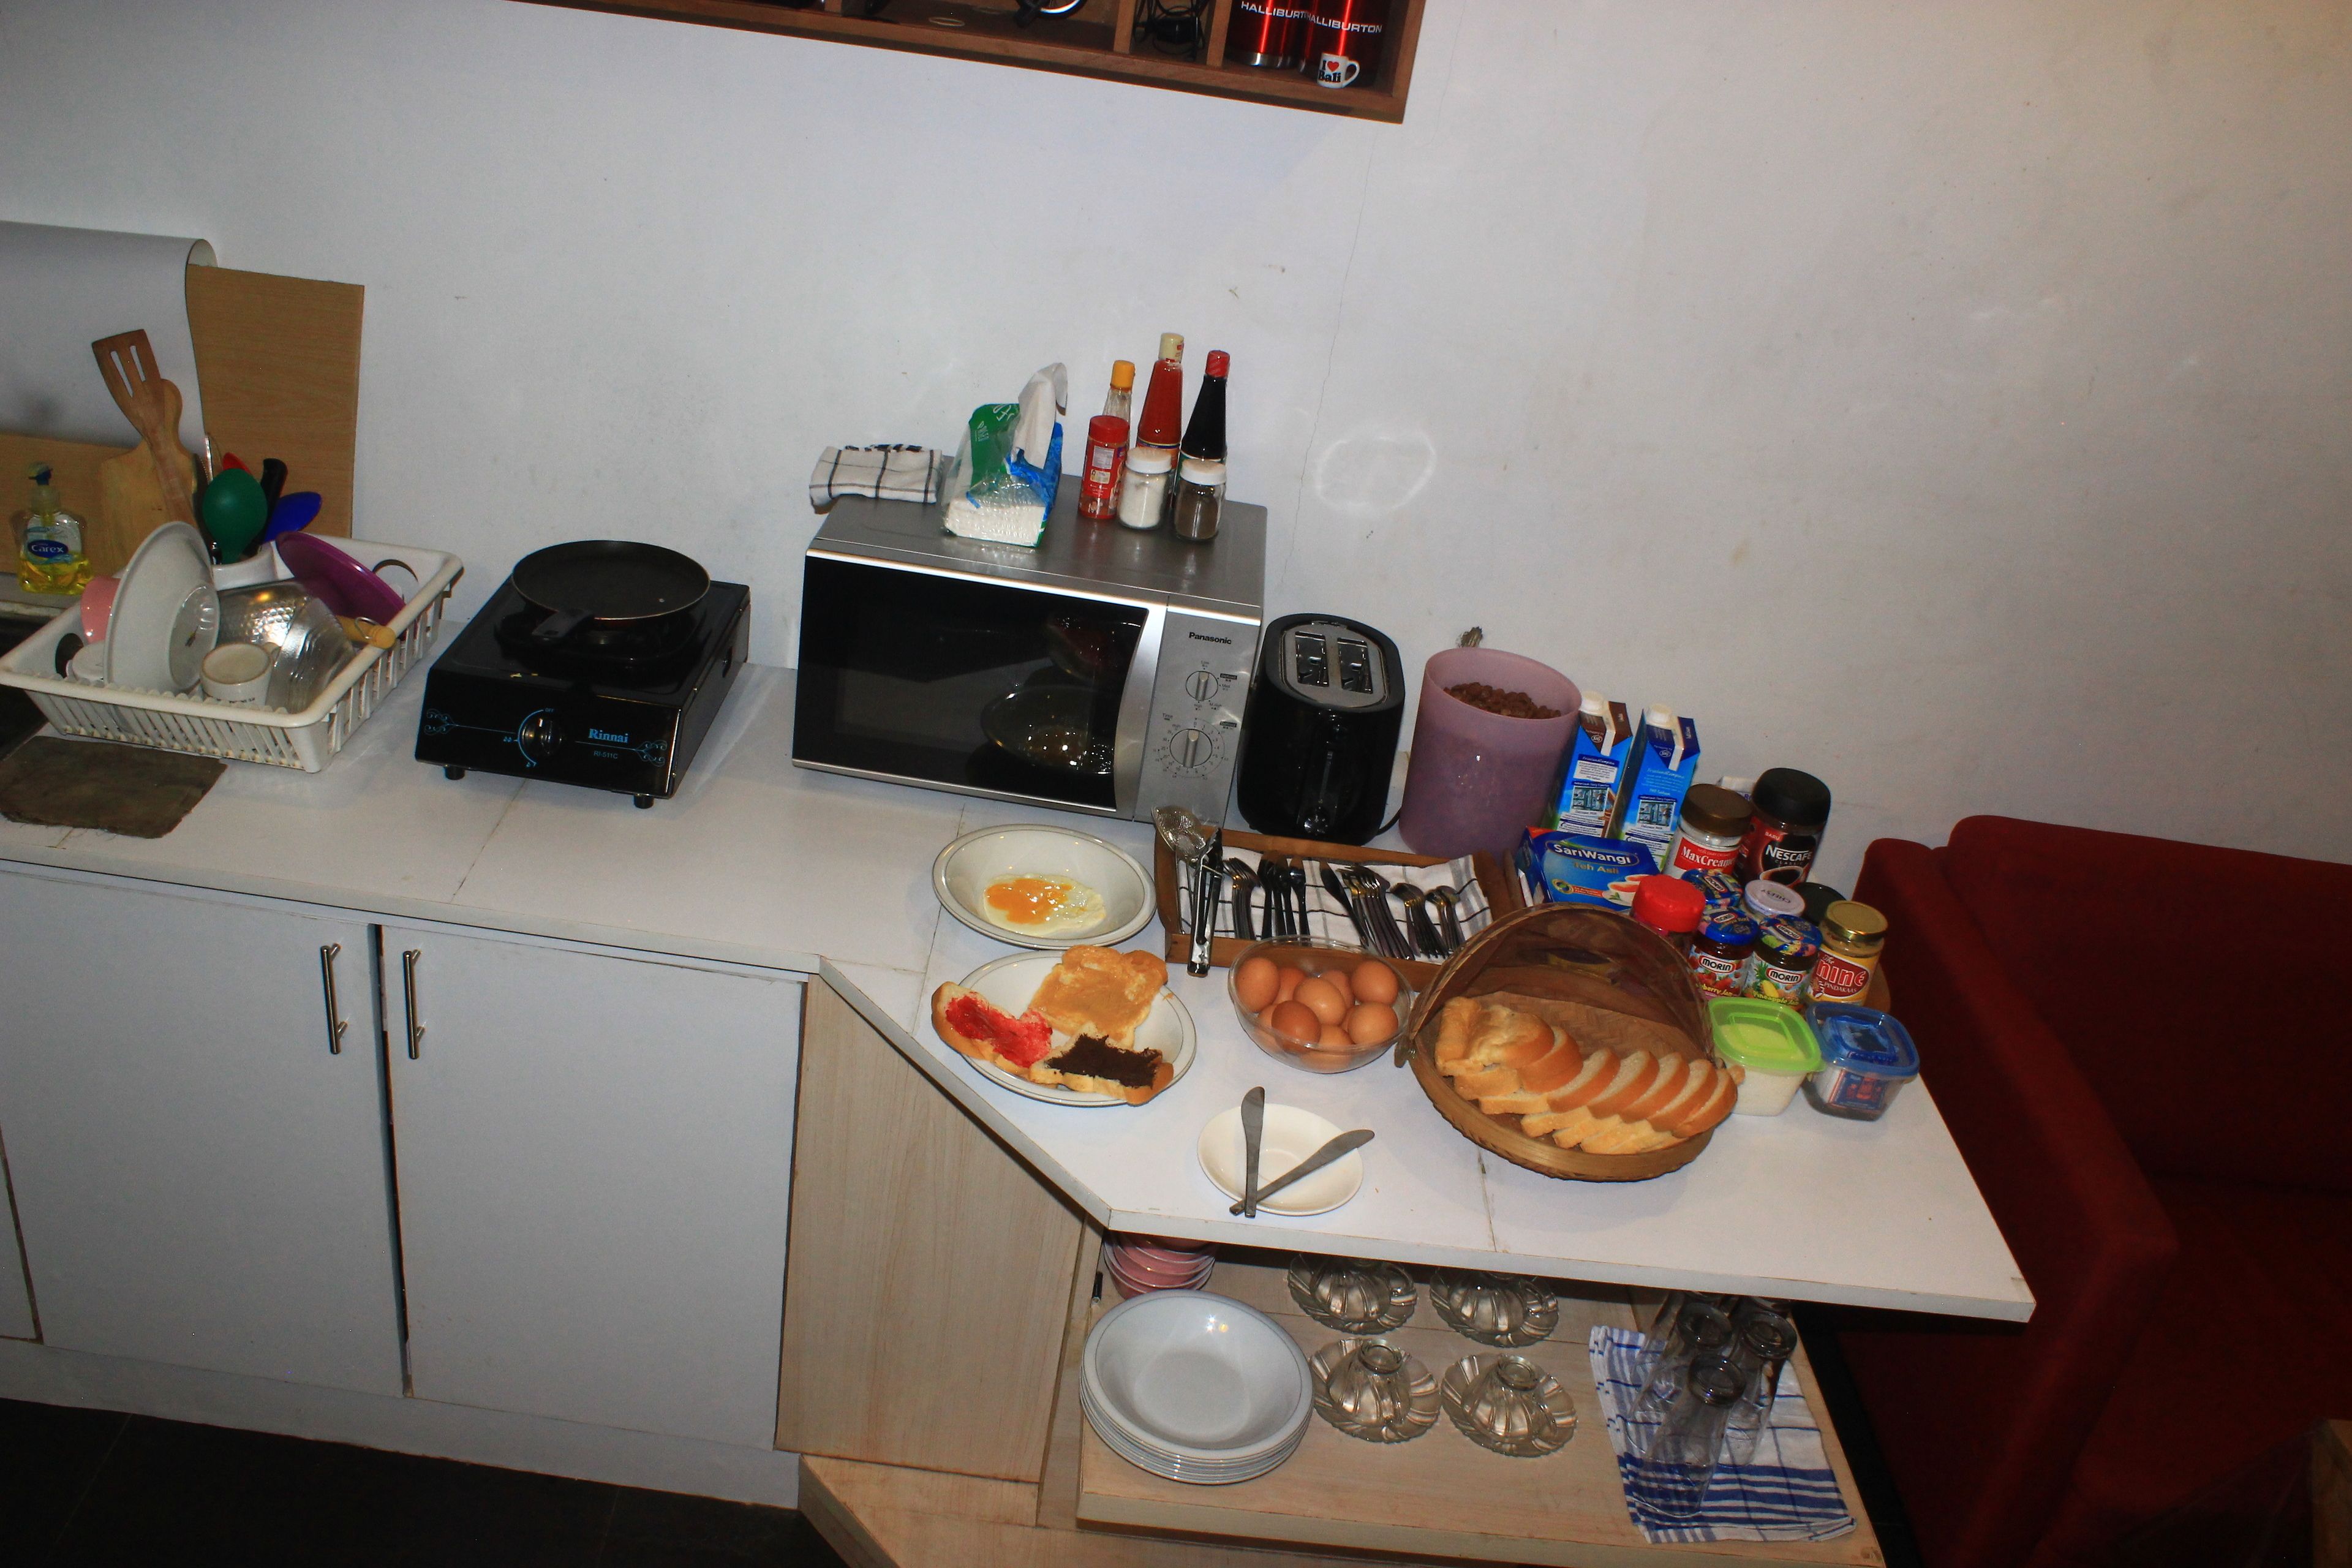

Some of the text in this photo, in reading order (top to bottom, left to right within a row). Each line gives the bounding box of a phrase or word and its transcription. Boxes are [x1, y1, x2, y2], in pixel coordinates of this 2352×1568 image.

[1306, 12, 1382, 33] HALLIBURTON
[1322, 59, 1327, 70] I
[1319, 69, 1341, 83] Bali
[31, 545, 64, 553] Carex
[1189, 631, 1232, 644] Panasonic
[588, 728, 628, 743] Rinnai
[594, 750, 618, 760] RI-511C
[1765, 831, 1780, 840] BARU
[1553, 844, 1631, 864] SariWangi
[1574, 862, 1619, 874] Teh Asli
[1702, 958, 1731, 971] MORIN
[1823, 954, 1835, 964] The
[1770, 971, 1799, 982] MORIN
[1824, 981, 1857, 993] PINDAKAAS
[1753, 990, 1787, 1004] Pineapple
